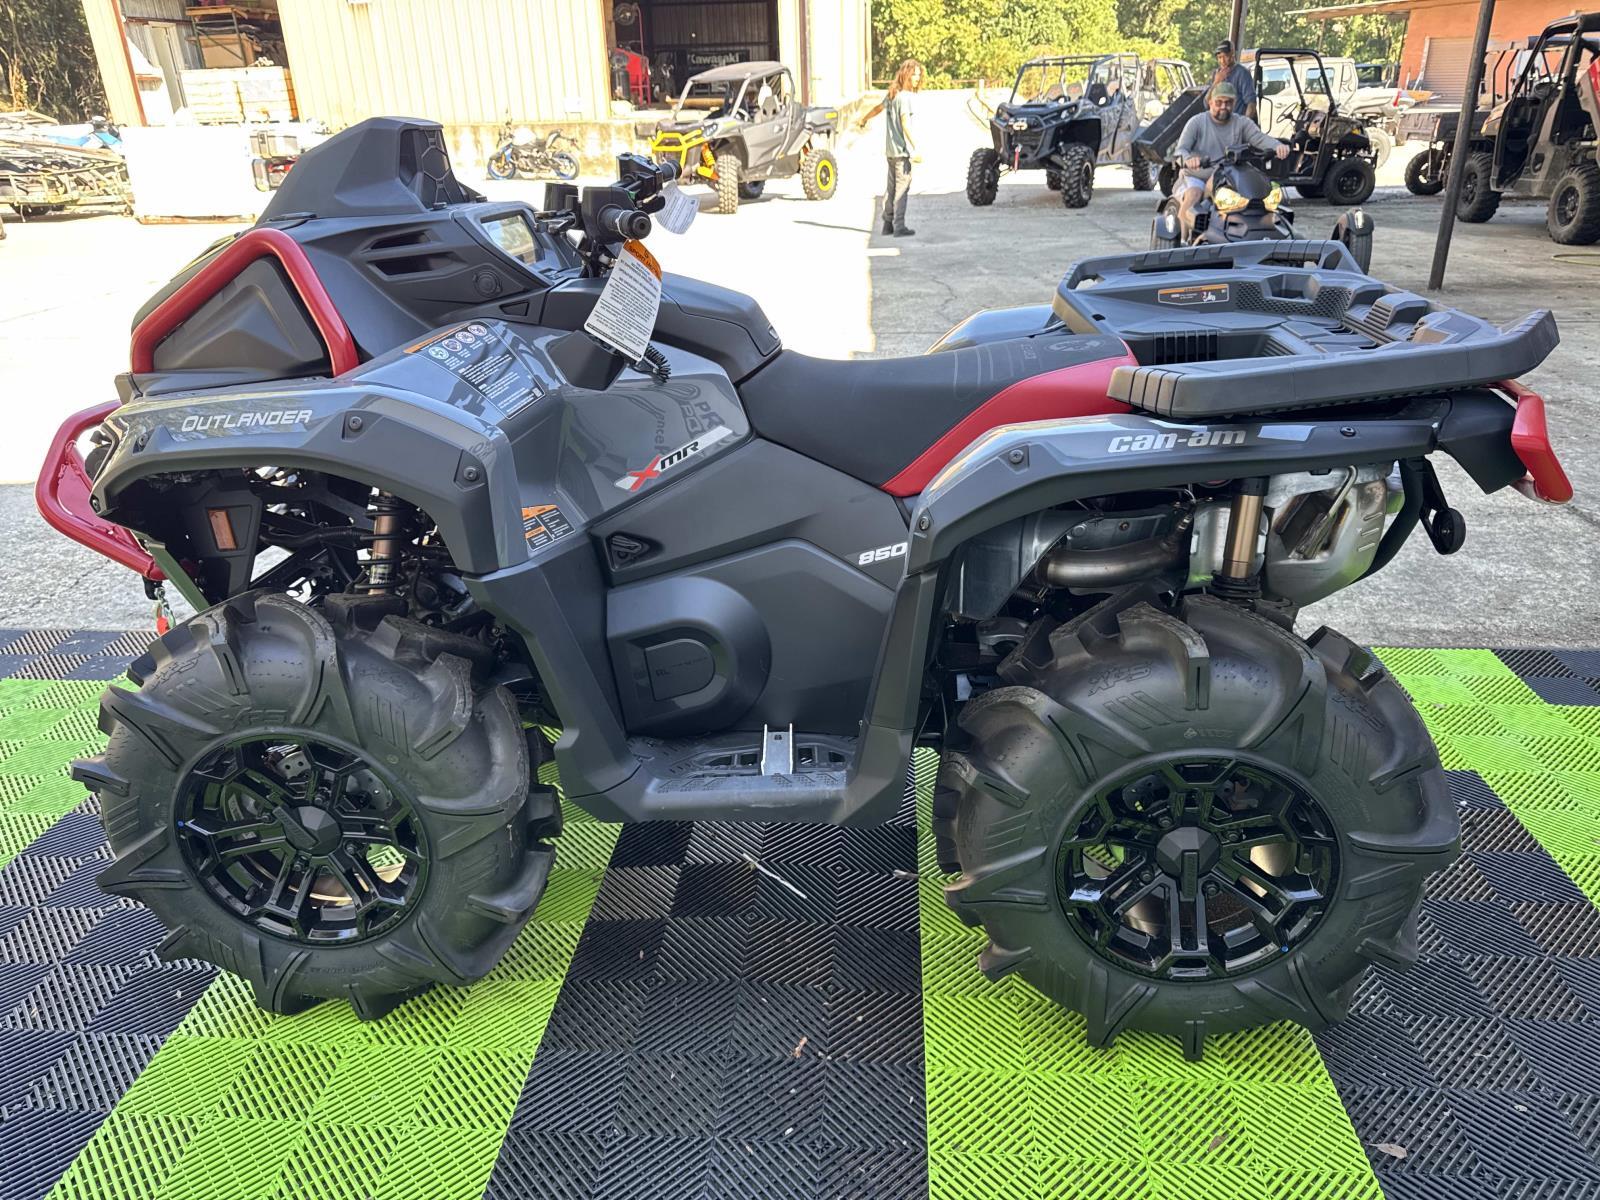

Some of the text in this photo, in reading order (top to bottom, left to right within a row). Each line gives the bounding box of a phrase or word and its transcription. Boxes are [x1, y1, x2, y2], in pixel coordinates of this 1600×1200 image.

[687, 53, 740, 65] Kawasaki
[181, 409, 313, 432] OUTLANDER
[1107, 429, 1247, 453] can-am
[858, 541, 909, 565] 850
